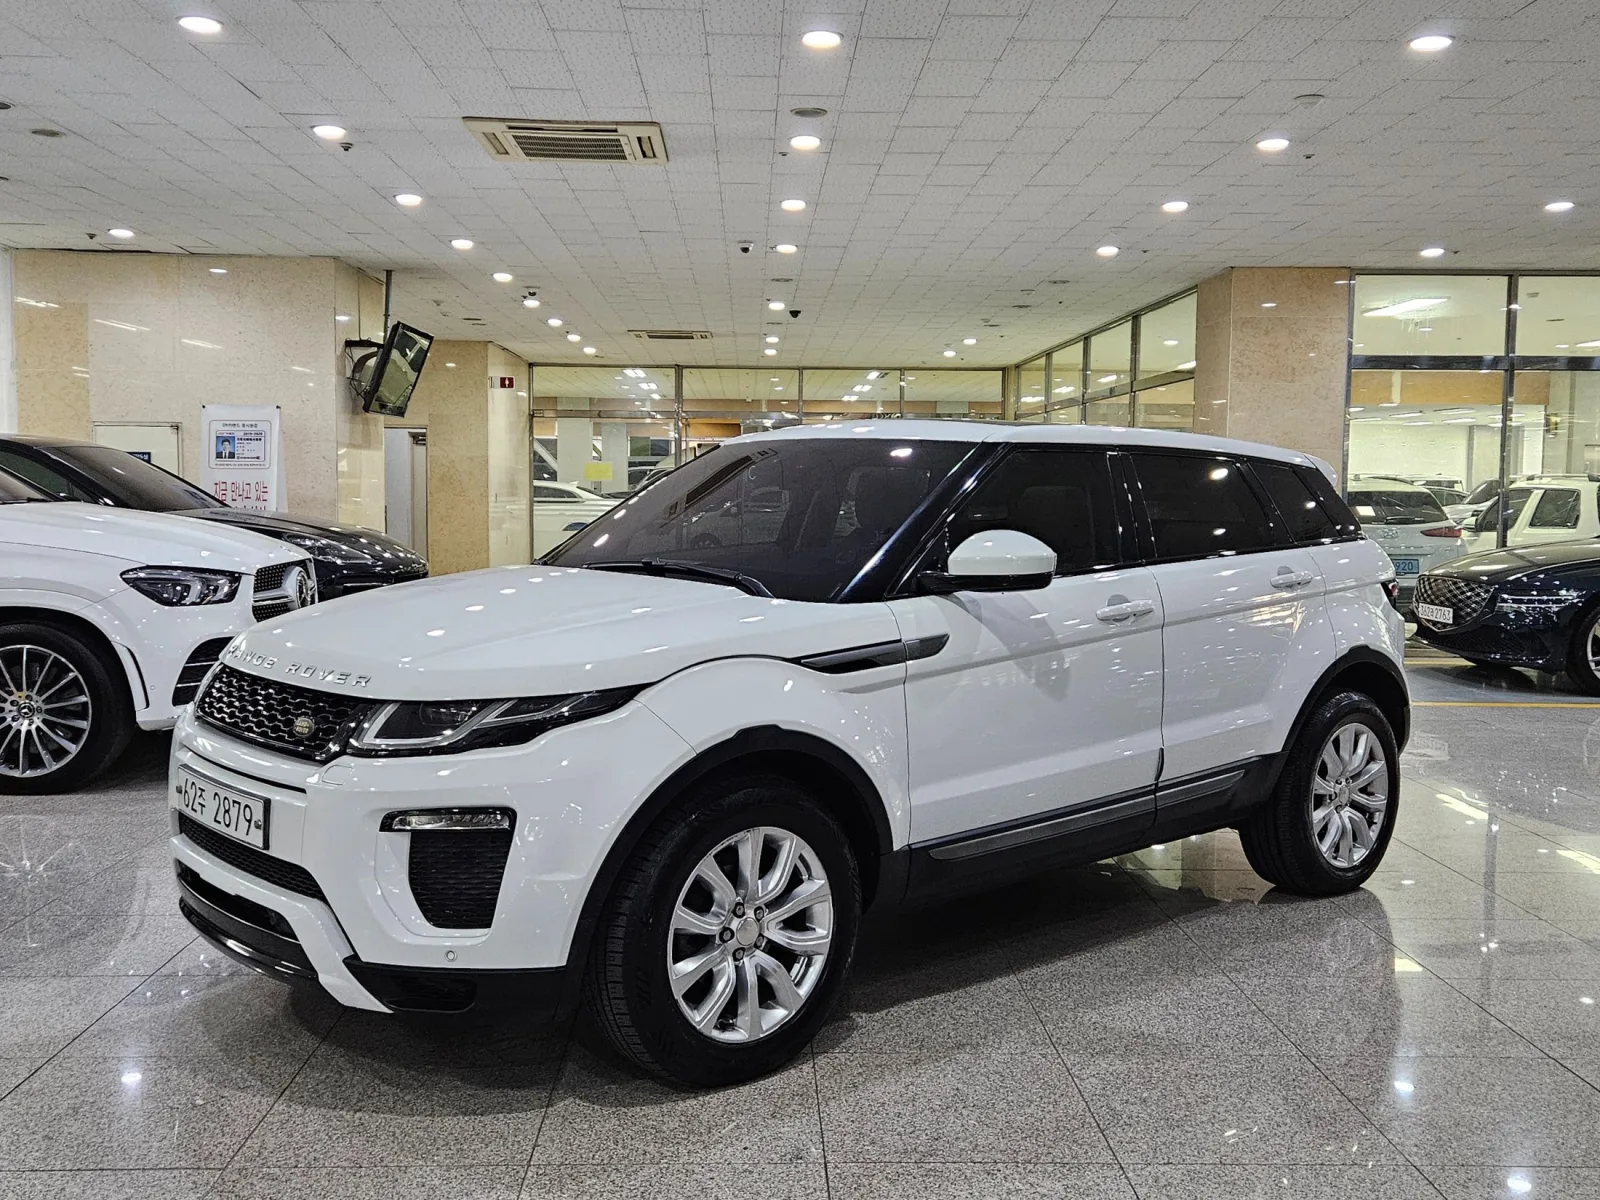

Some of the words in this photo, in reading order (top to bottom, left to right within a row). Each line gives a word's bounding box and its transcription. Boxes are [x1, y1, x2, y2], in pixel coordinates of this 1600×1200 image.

[214, 480, 228, 502] 지금
[231, 480, 252, 502] 만나고
[254, 480, 269, 502] 있는
[1393, 561, 1414, 572] 920
[1434, 607, 1451, 621] 2763
[228, 645, 280, 670] RANGE
[285, 662, 372, 688] ROVER
[183, 778, 206, 815] 62주
[213, 792, 253, 836] 2879
